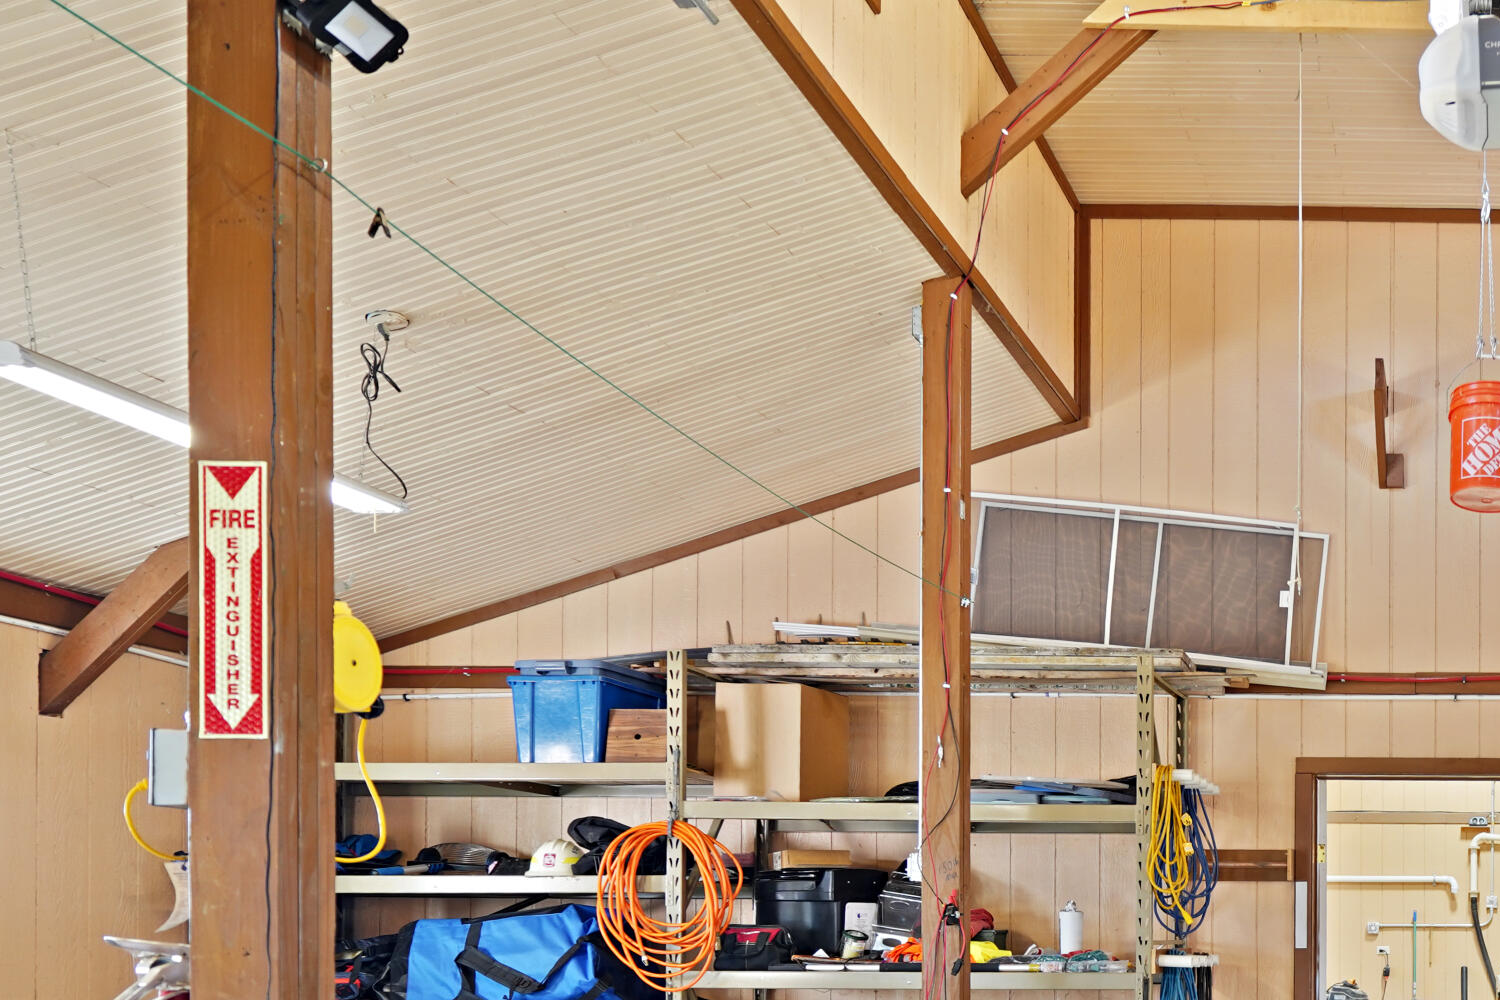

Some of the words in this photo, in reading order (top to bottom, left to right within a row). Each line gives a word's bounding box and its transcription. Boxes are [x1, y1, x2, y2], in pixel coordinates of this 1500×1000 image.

[1466, 423, 1492, 447] THE
[209, 509, 256, 528] FIRE
[226, 537, 240, 710] EXTINGUISHER
